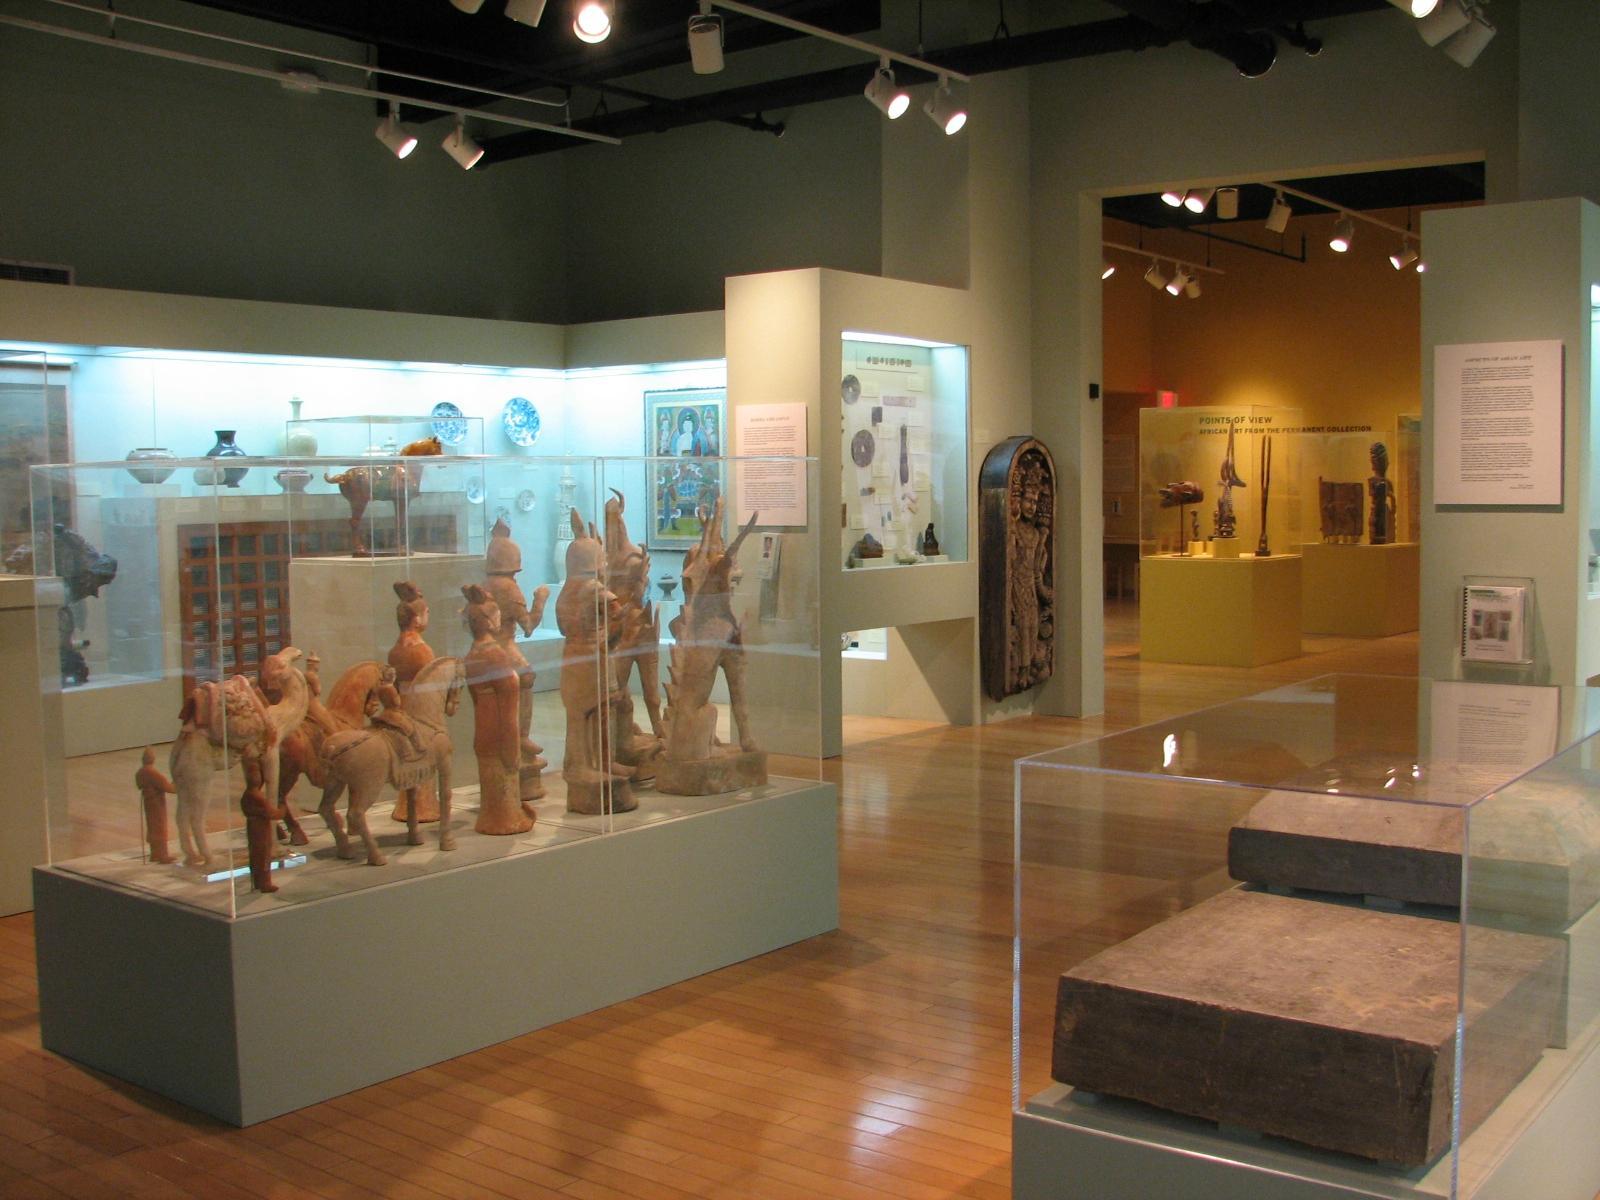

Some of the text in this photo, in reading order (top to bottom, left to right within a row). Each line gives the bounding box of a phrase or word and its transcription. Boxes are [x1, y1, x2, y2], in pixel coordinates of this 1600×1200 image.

[1199, 416, 1273, 425] POINTS OF VIEW
[1326, 425, 1372, 433] COLLECTION
